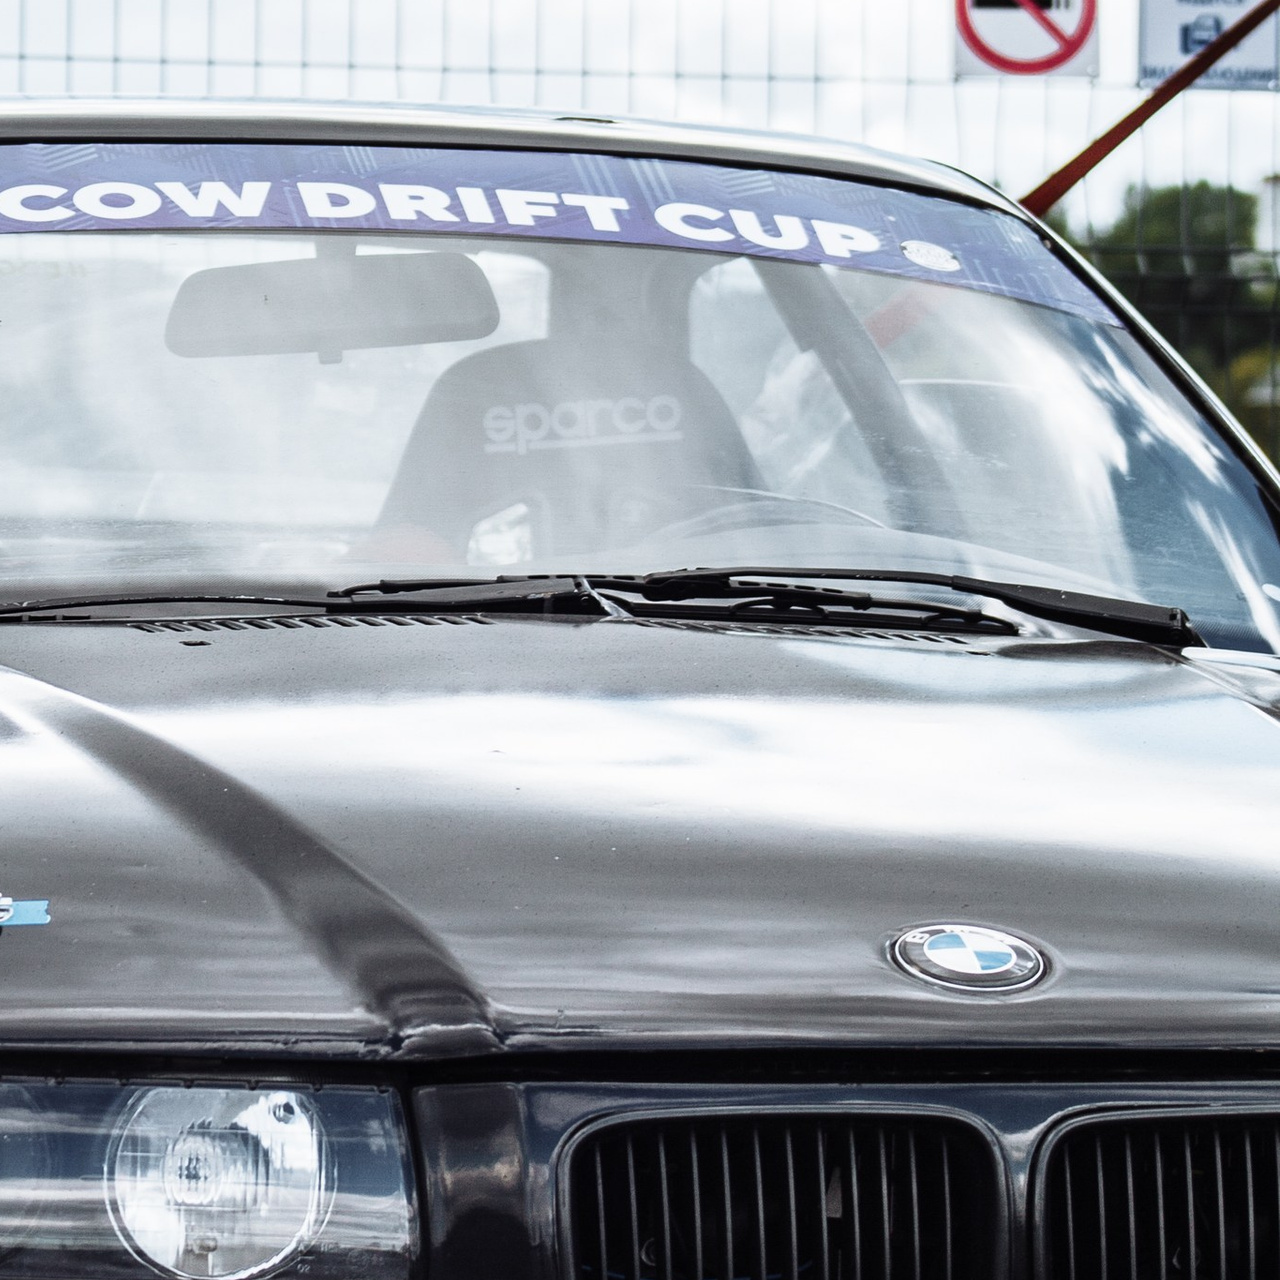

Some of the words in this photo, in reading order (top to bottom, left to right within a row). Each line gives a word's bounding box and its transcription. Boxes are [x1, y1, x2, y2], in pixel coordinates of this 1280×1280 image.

[296, 182, 630, 232] DRIFT
[654, 202, 882, 258] CUP
[482, 393, 682, 456] sparco
